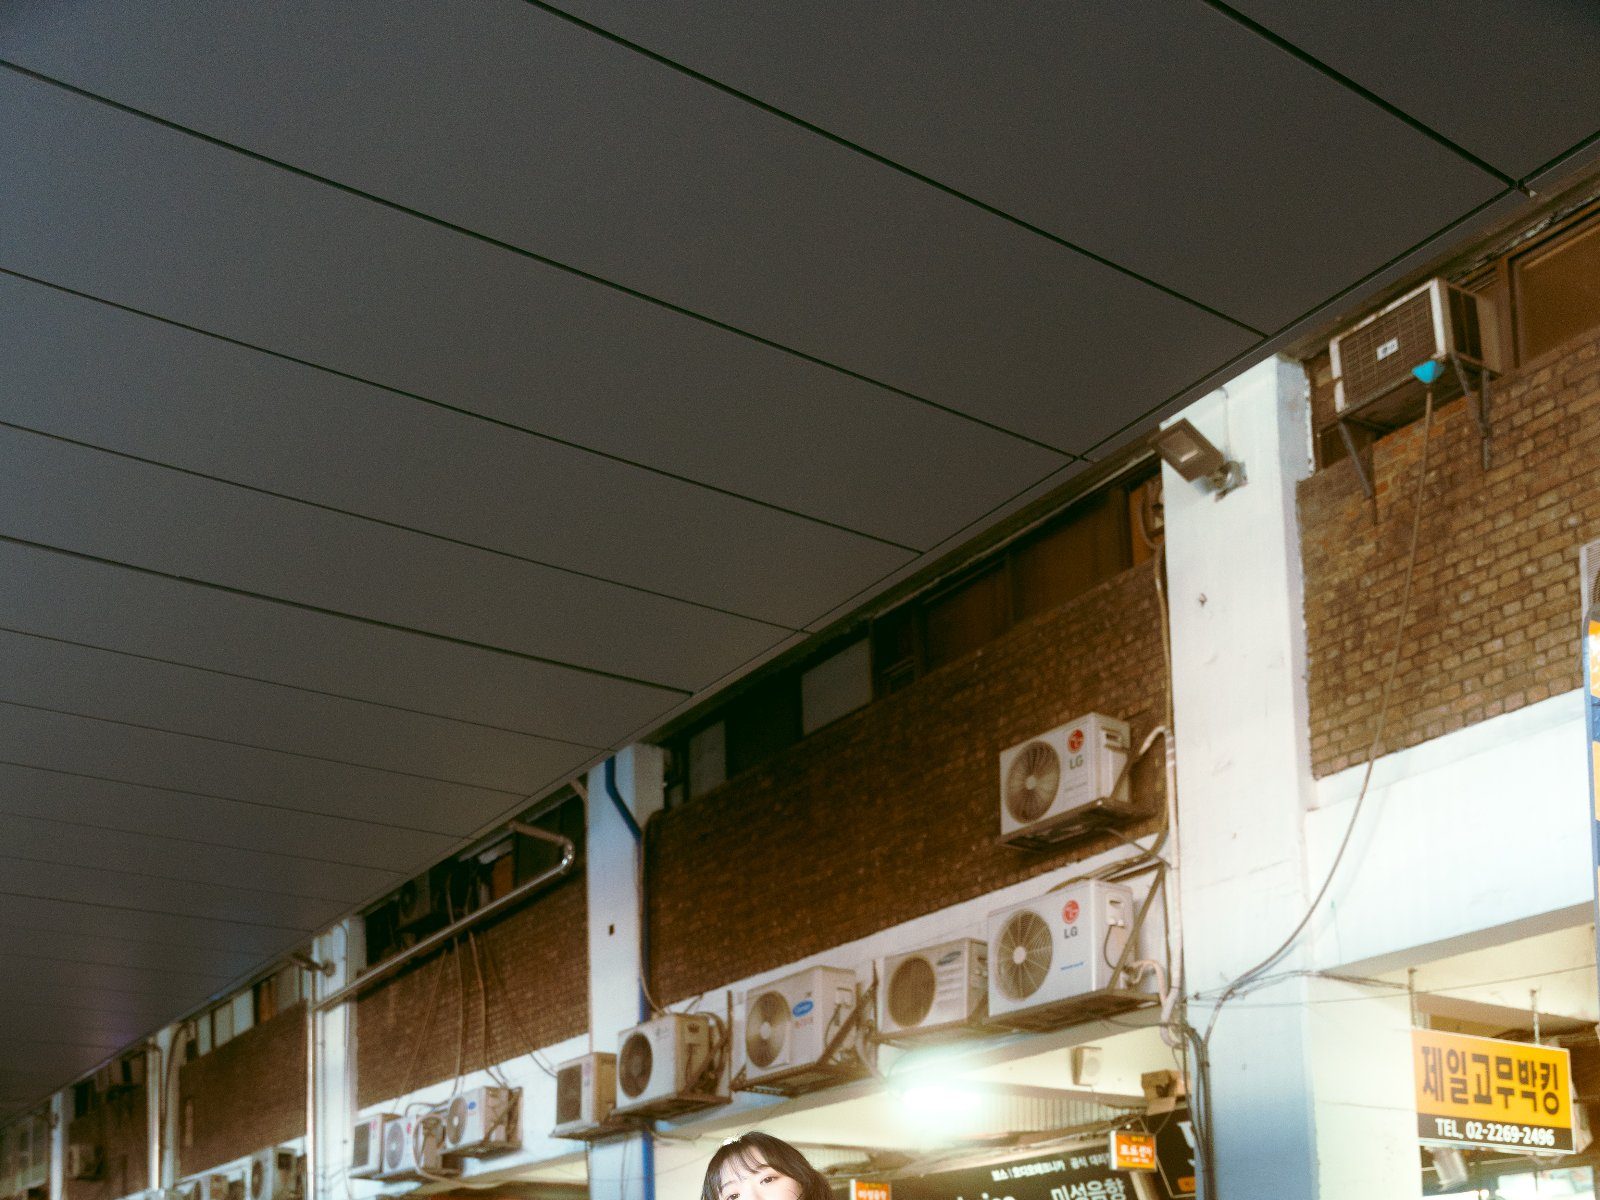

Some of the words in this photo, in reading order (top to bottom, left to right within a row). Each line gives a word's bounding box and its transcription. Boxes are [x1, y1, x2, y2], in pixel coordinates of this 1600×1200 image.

[1069, 754, 1083, 770] LG
[1063, 925, 1078, 939] LG
[1421, 1046, 1560, 1115] 제일고무박킹
[1435, 1118, 1464, 1139] TEL.
[1465, 1120, 1555, 1147] 02-2269-2496
